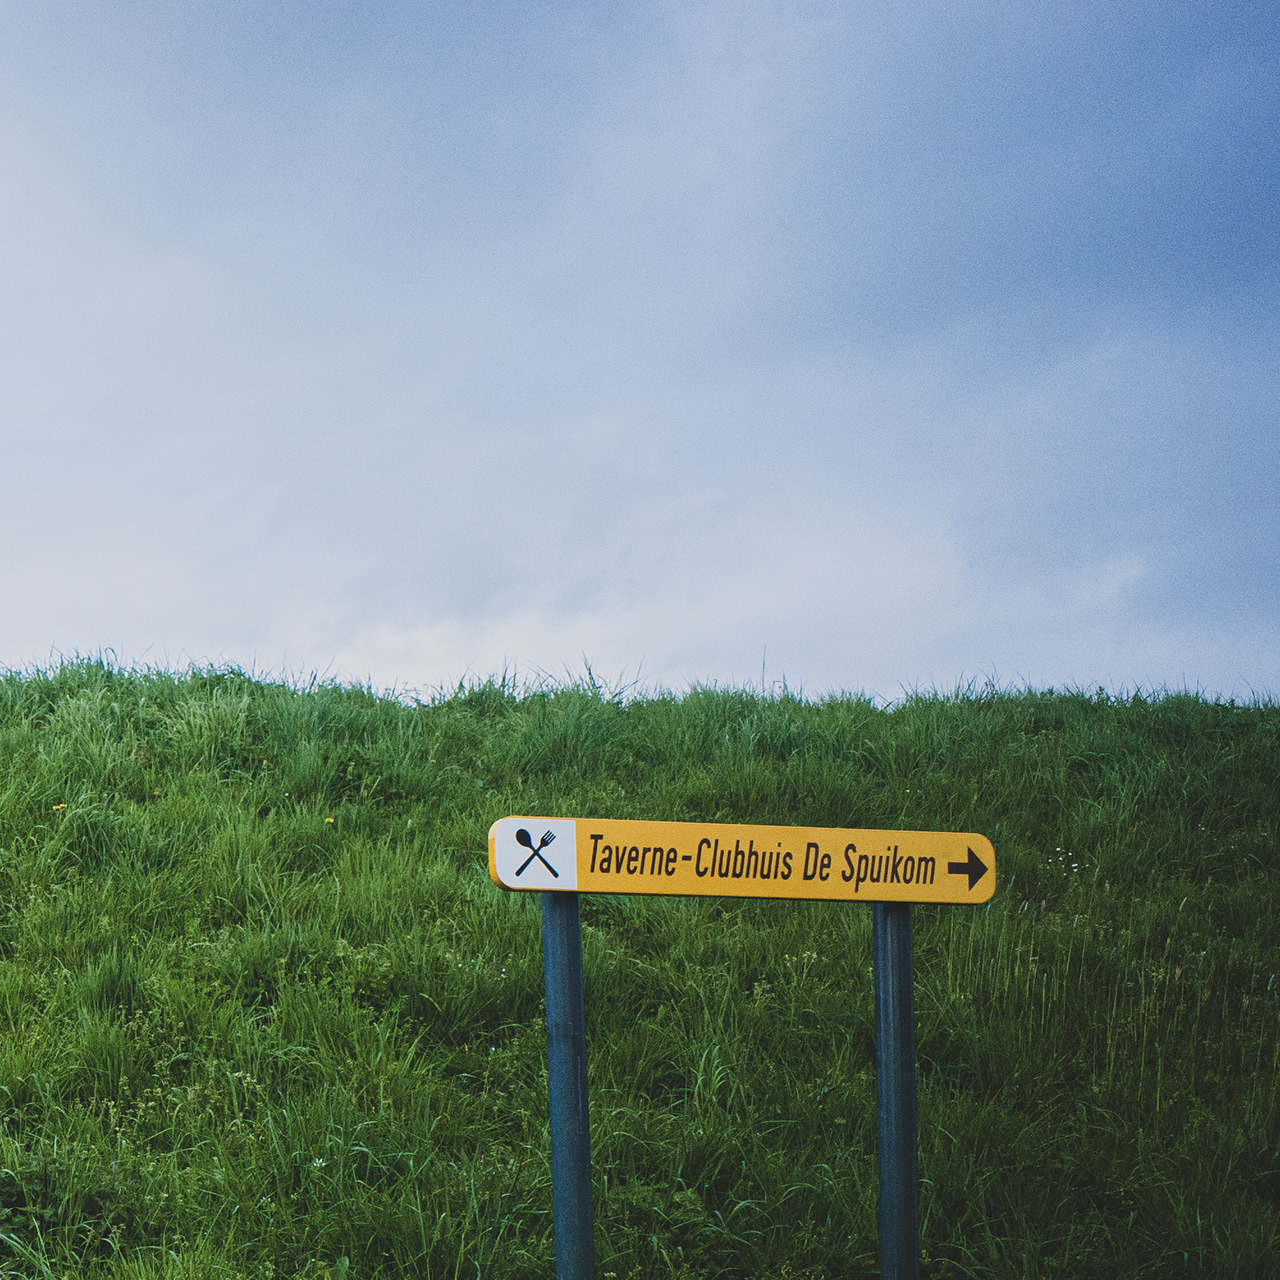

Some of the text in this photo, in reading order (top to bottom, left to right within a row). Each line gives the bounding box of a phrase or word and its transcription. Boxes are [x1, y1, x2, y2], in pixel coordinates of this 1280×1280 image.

[589, 834, 936, 893] Taverne-Clubhuis De Spuikom
